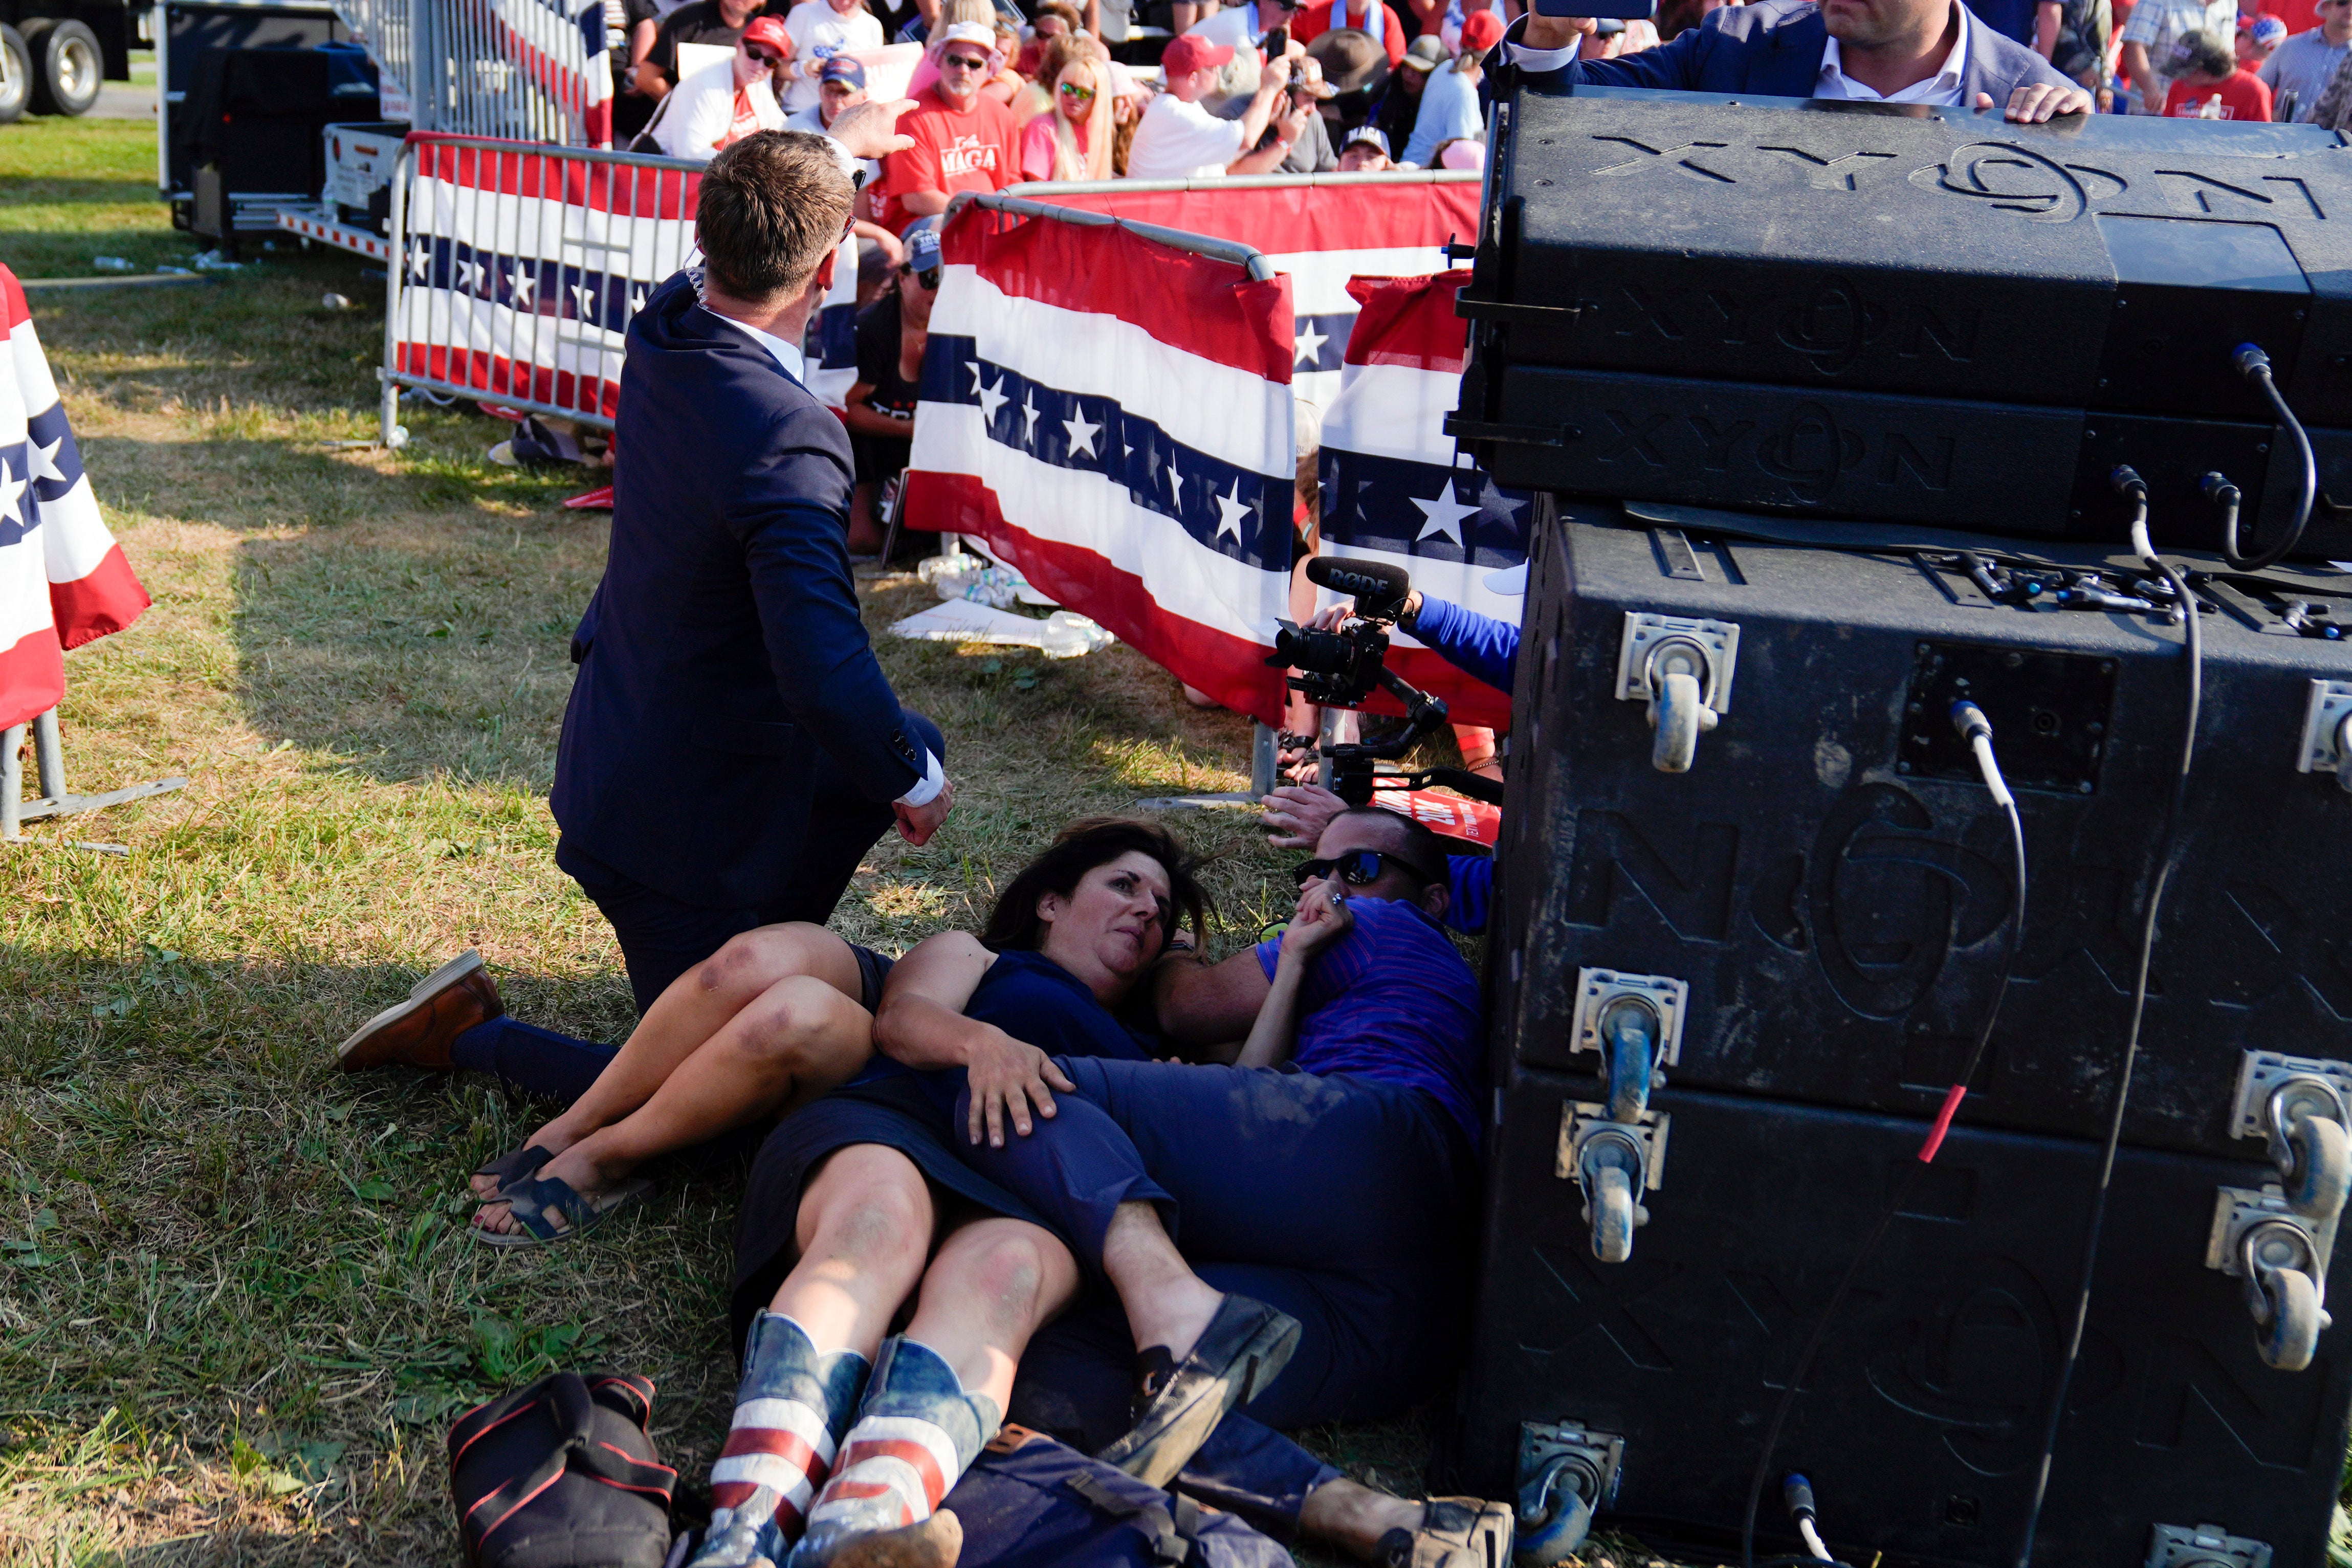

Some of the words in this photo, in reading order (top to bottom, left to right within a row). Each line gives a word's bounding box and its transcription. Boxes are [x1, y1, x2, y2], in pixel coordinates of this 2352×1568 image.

[1348, 126, 1382, 145] MAGA
[940, 148, 997, 171] MAGA
[1589, 135, 2326, 224] XYON
[1615, 273, 1981, 377] XYON
[1597, 401, 1957, 505] XYON
[1328, 568, 1389, 595] RØDE
[1414, 797, 1456, 826] 2024
